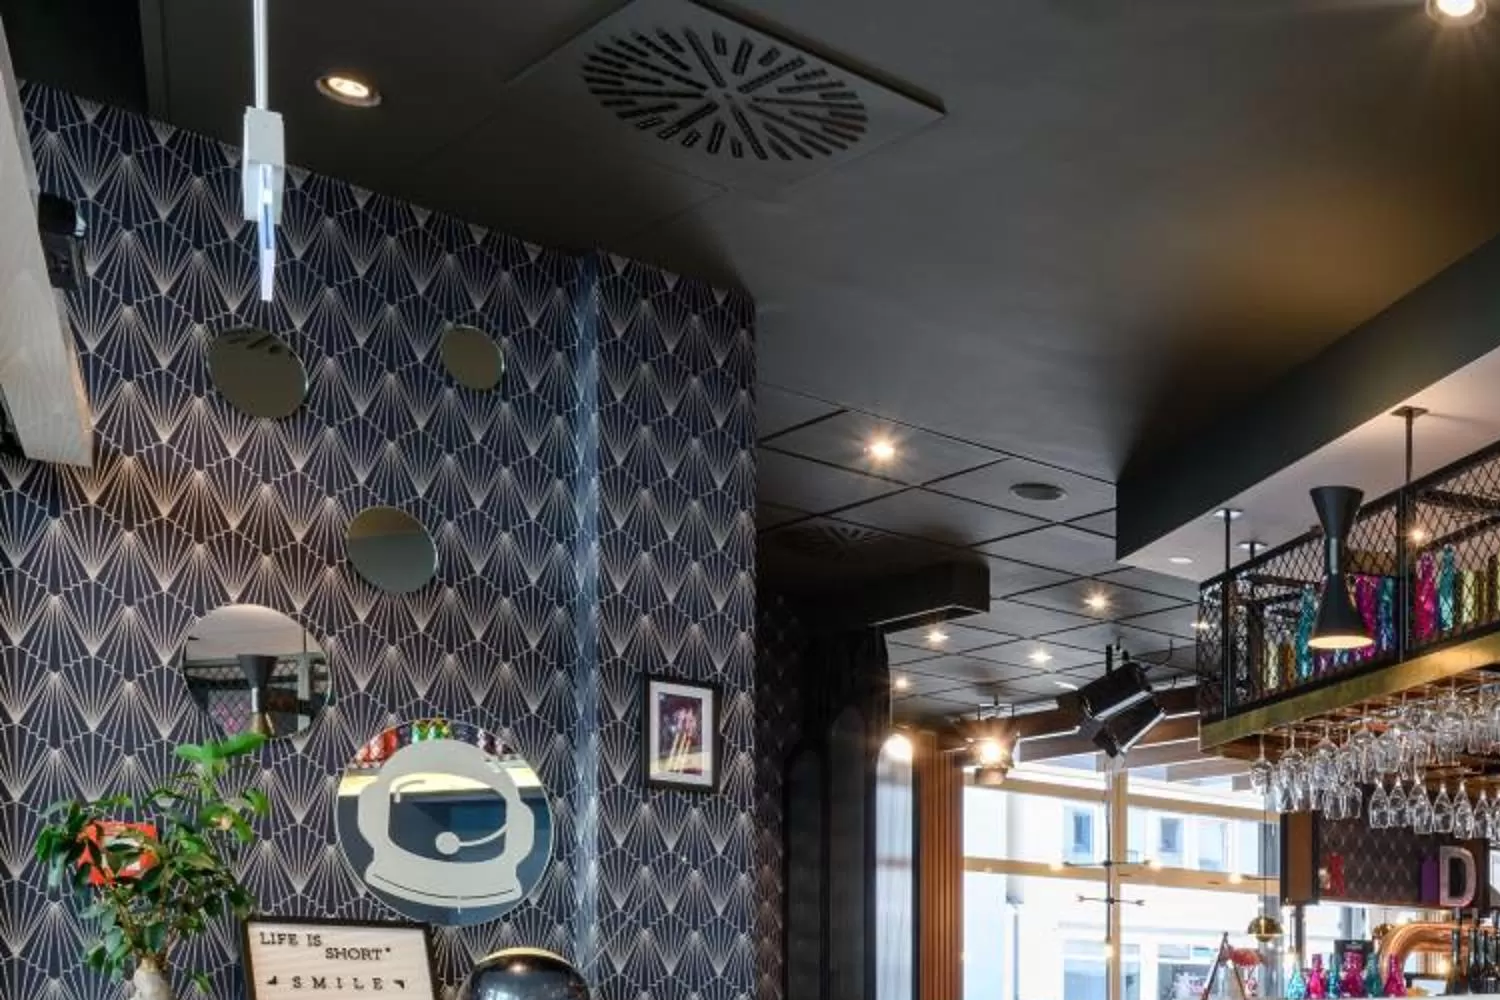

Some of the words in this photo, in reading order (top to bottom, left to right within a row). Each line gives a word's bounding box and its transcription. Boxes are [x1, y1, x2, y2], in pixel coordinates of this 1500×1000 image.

[1440, 845, 1477, 907] D
[260, 932, 298, 946] LIFE
[307, 933, 322, 947] IS
